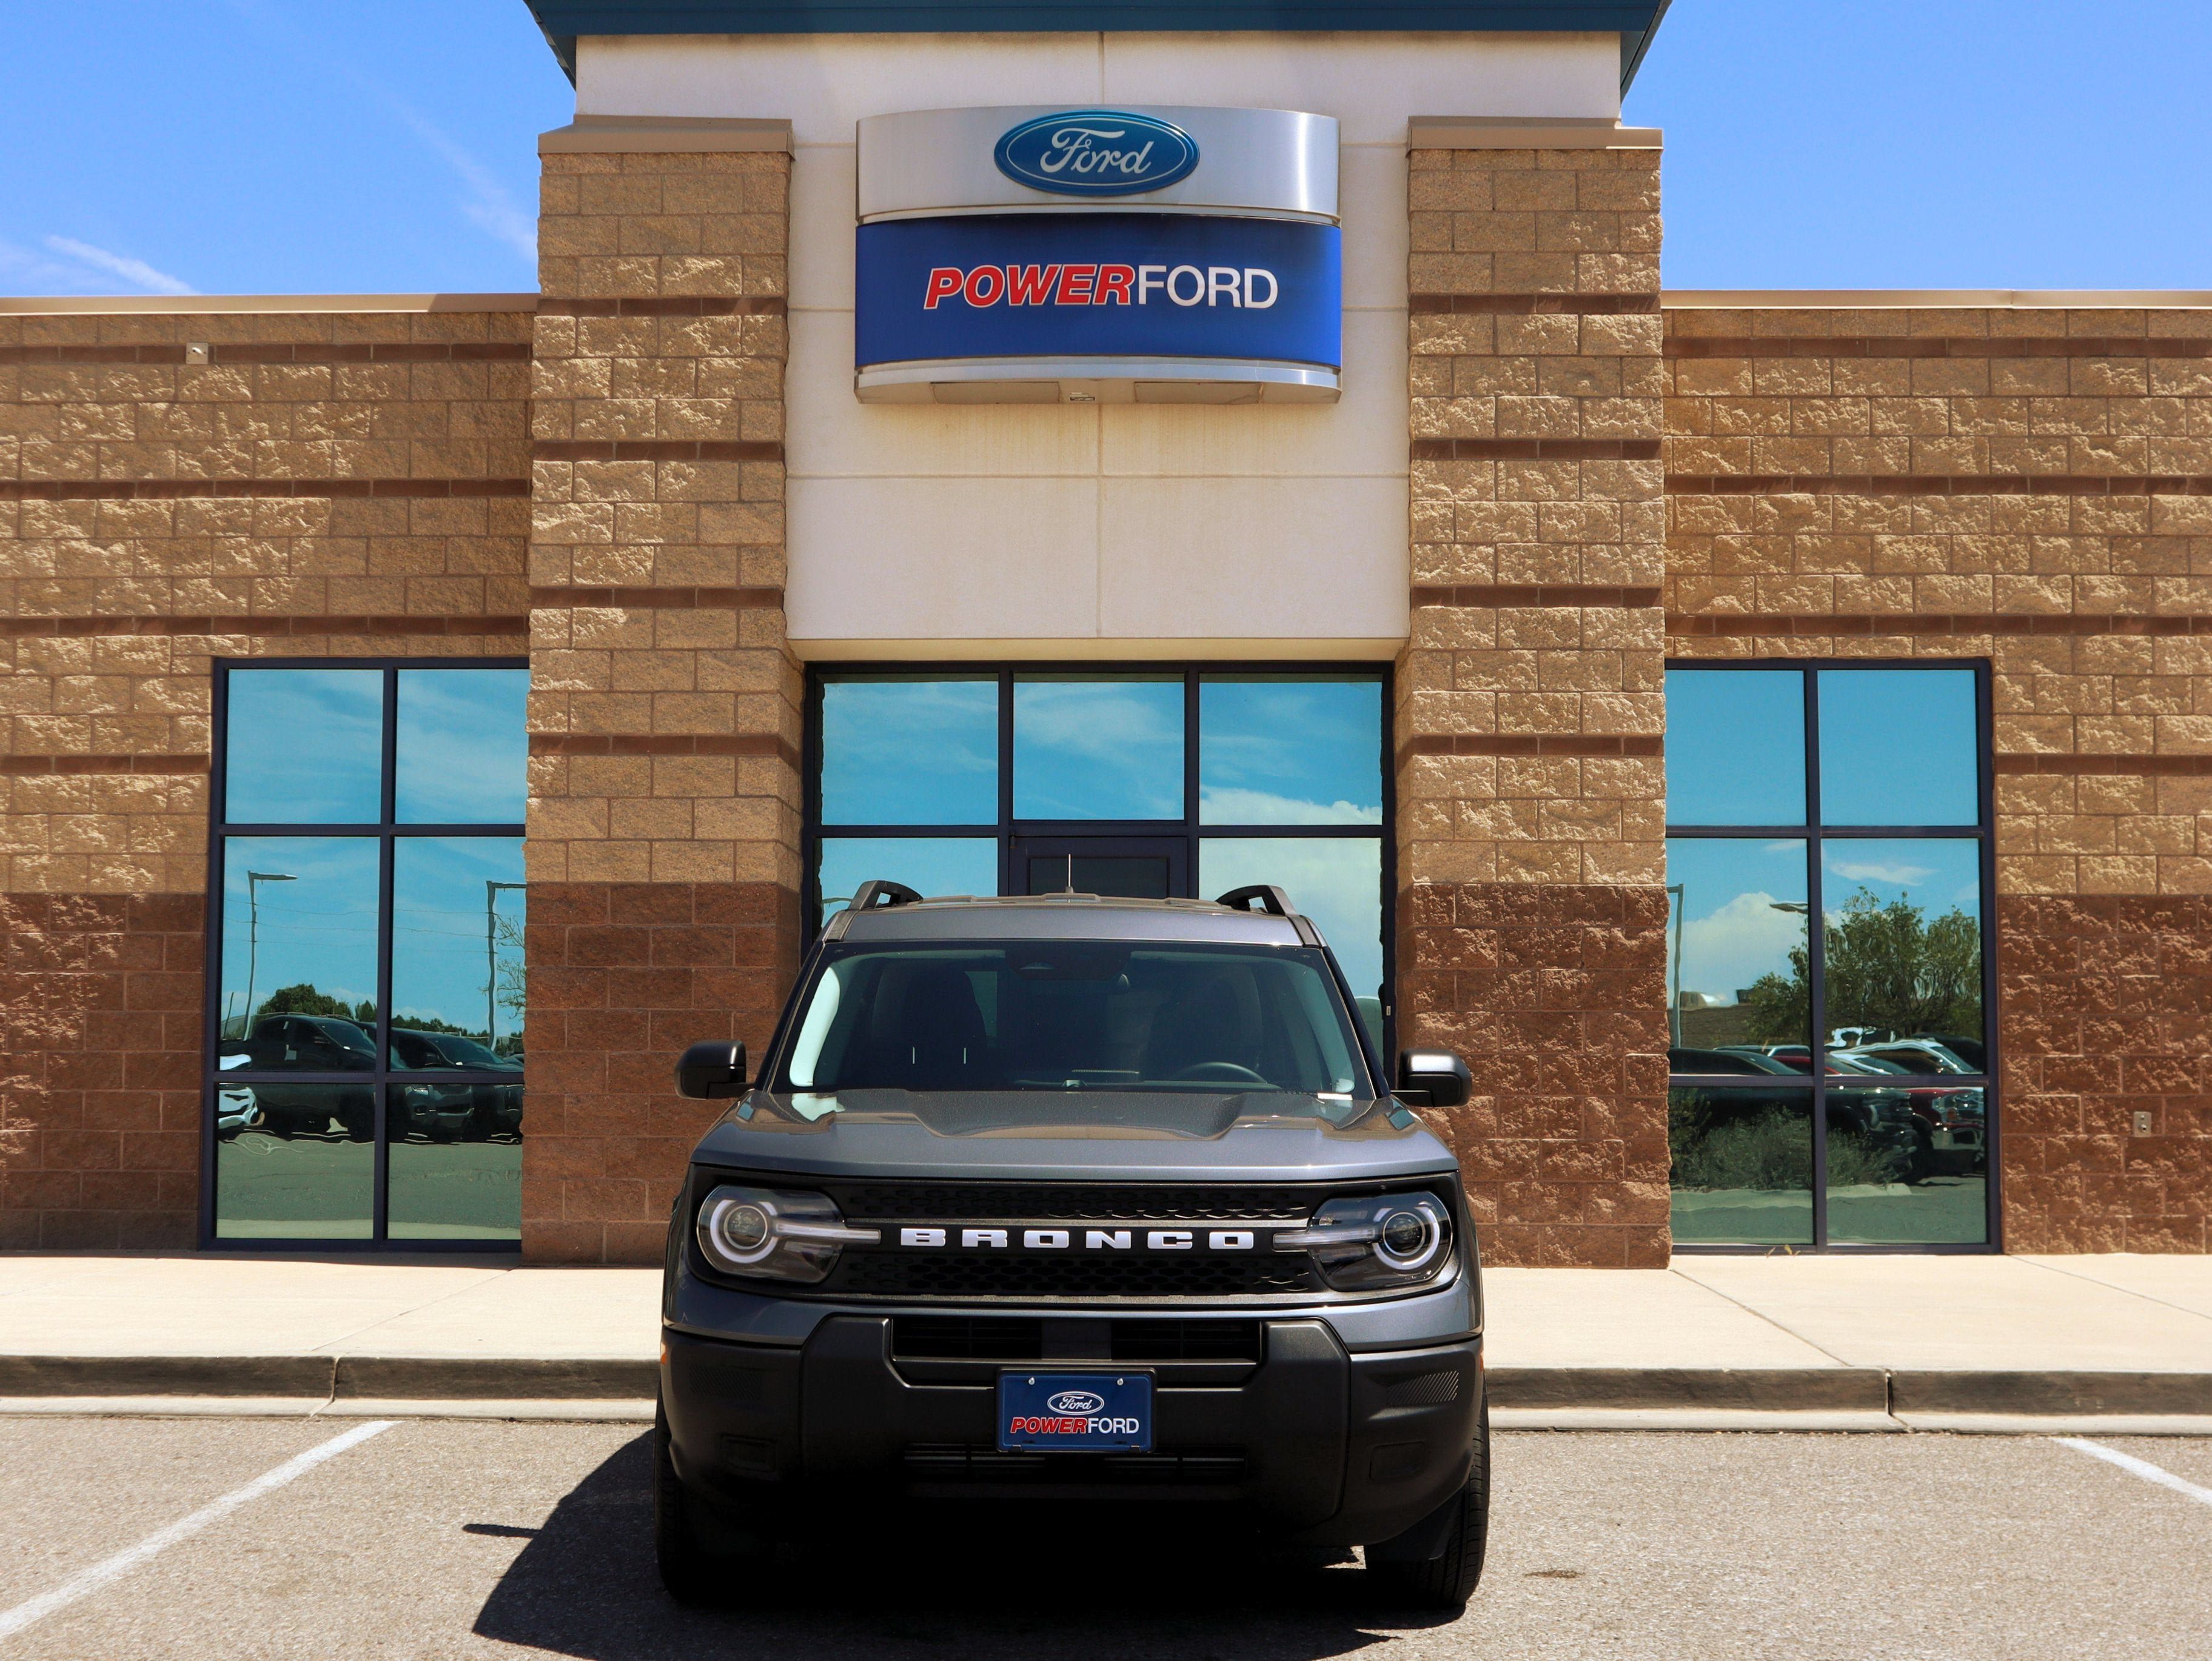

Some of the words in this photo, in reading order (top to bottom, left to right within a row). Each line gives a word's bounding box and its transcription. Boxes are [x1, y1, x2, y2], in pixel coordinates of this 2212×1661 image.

[1039, 127, 1154, 174] Ford
[900, 1229, 1254, 1249] BRONCO
[1059, 1395, 1093, 1410] Ford
